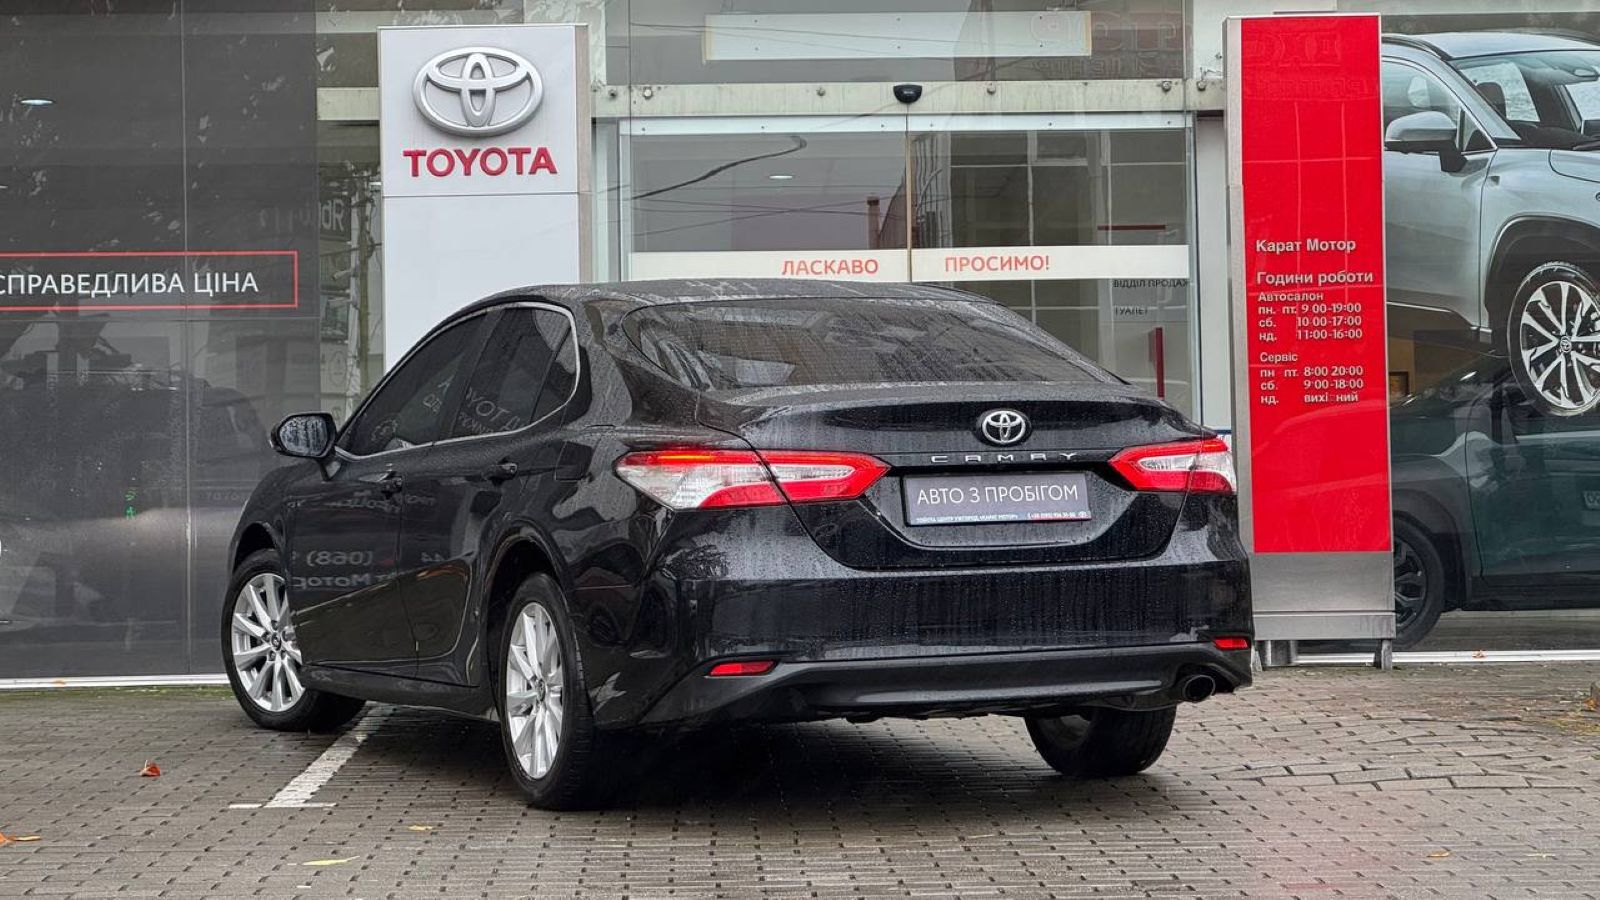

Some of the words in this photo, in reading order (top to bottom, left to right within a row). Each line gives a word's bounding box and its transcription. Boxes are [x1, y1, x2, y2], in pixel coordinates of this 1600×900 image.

[403, 147, 558, 177] TOYOTA
[1256, 240, 1302, 255] Карат
[1306, 238, 1356, 254] Мотор
[781, 259, 879, 275] ЛАСКАВО
[945, 255, 1049, 272] ПРОСИМО!
[194, 272, 259, 297] ЦІНА
[1256, 271, 1313, 286] Години
[1318, 270, 1373, 286] роботи
[1258, 291, 1324, 302] Автосалон
[1258, 306, 1276, 315] пн.
[1259, 317, 1277, 328] сб.
[1259, 332, 1278, 342] нд.
[1296, 329, 1363, 340] 11:00-16:00
[1260, 352, 1299, 363] Сервіс
[1260, 395, 1279, 405] нд.
[1303, 391, 1359, 403] вихіний
[931, 452, 1077, 463] CAMRY
[917, 487, 964, 505] АВТО
[984, 484, 1079, 503] ПРОБІГОМ
